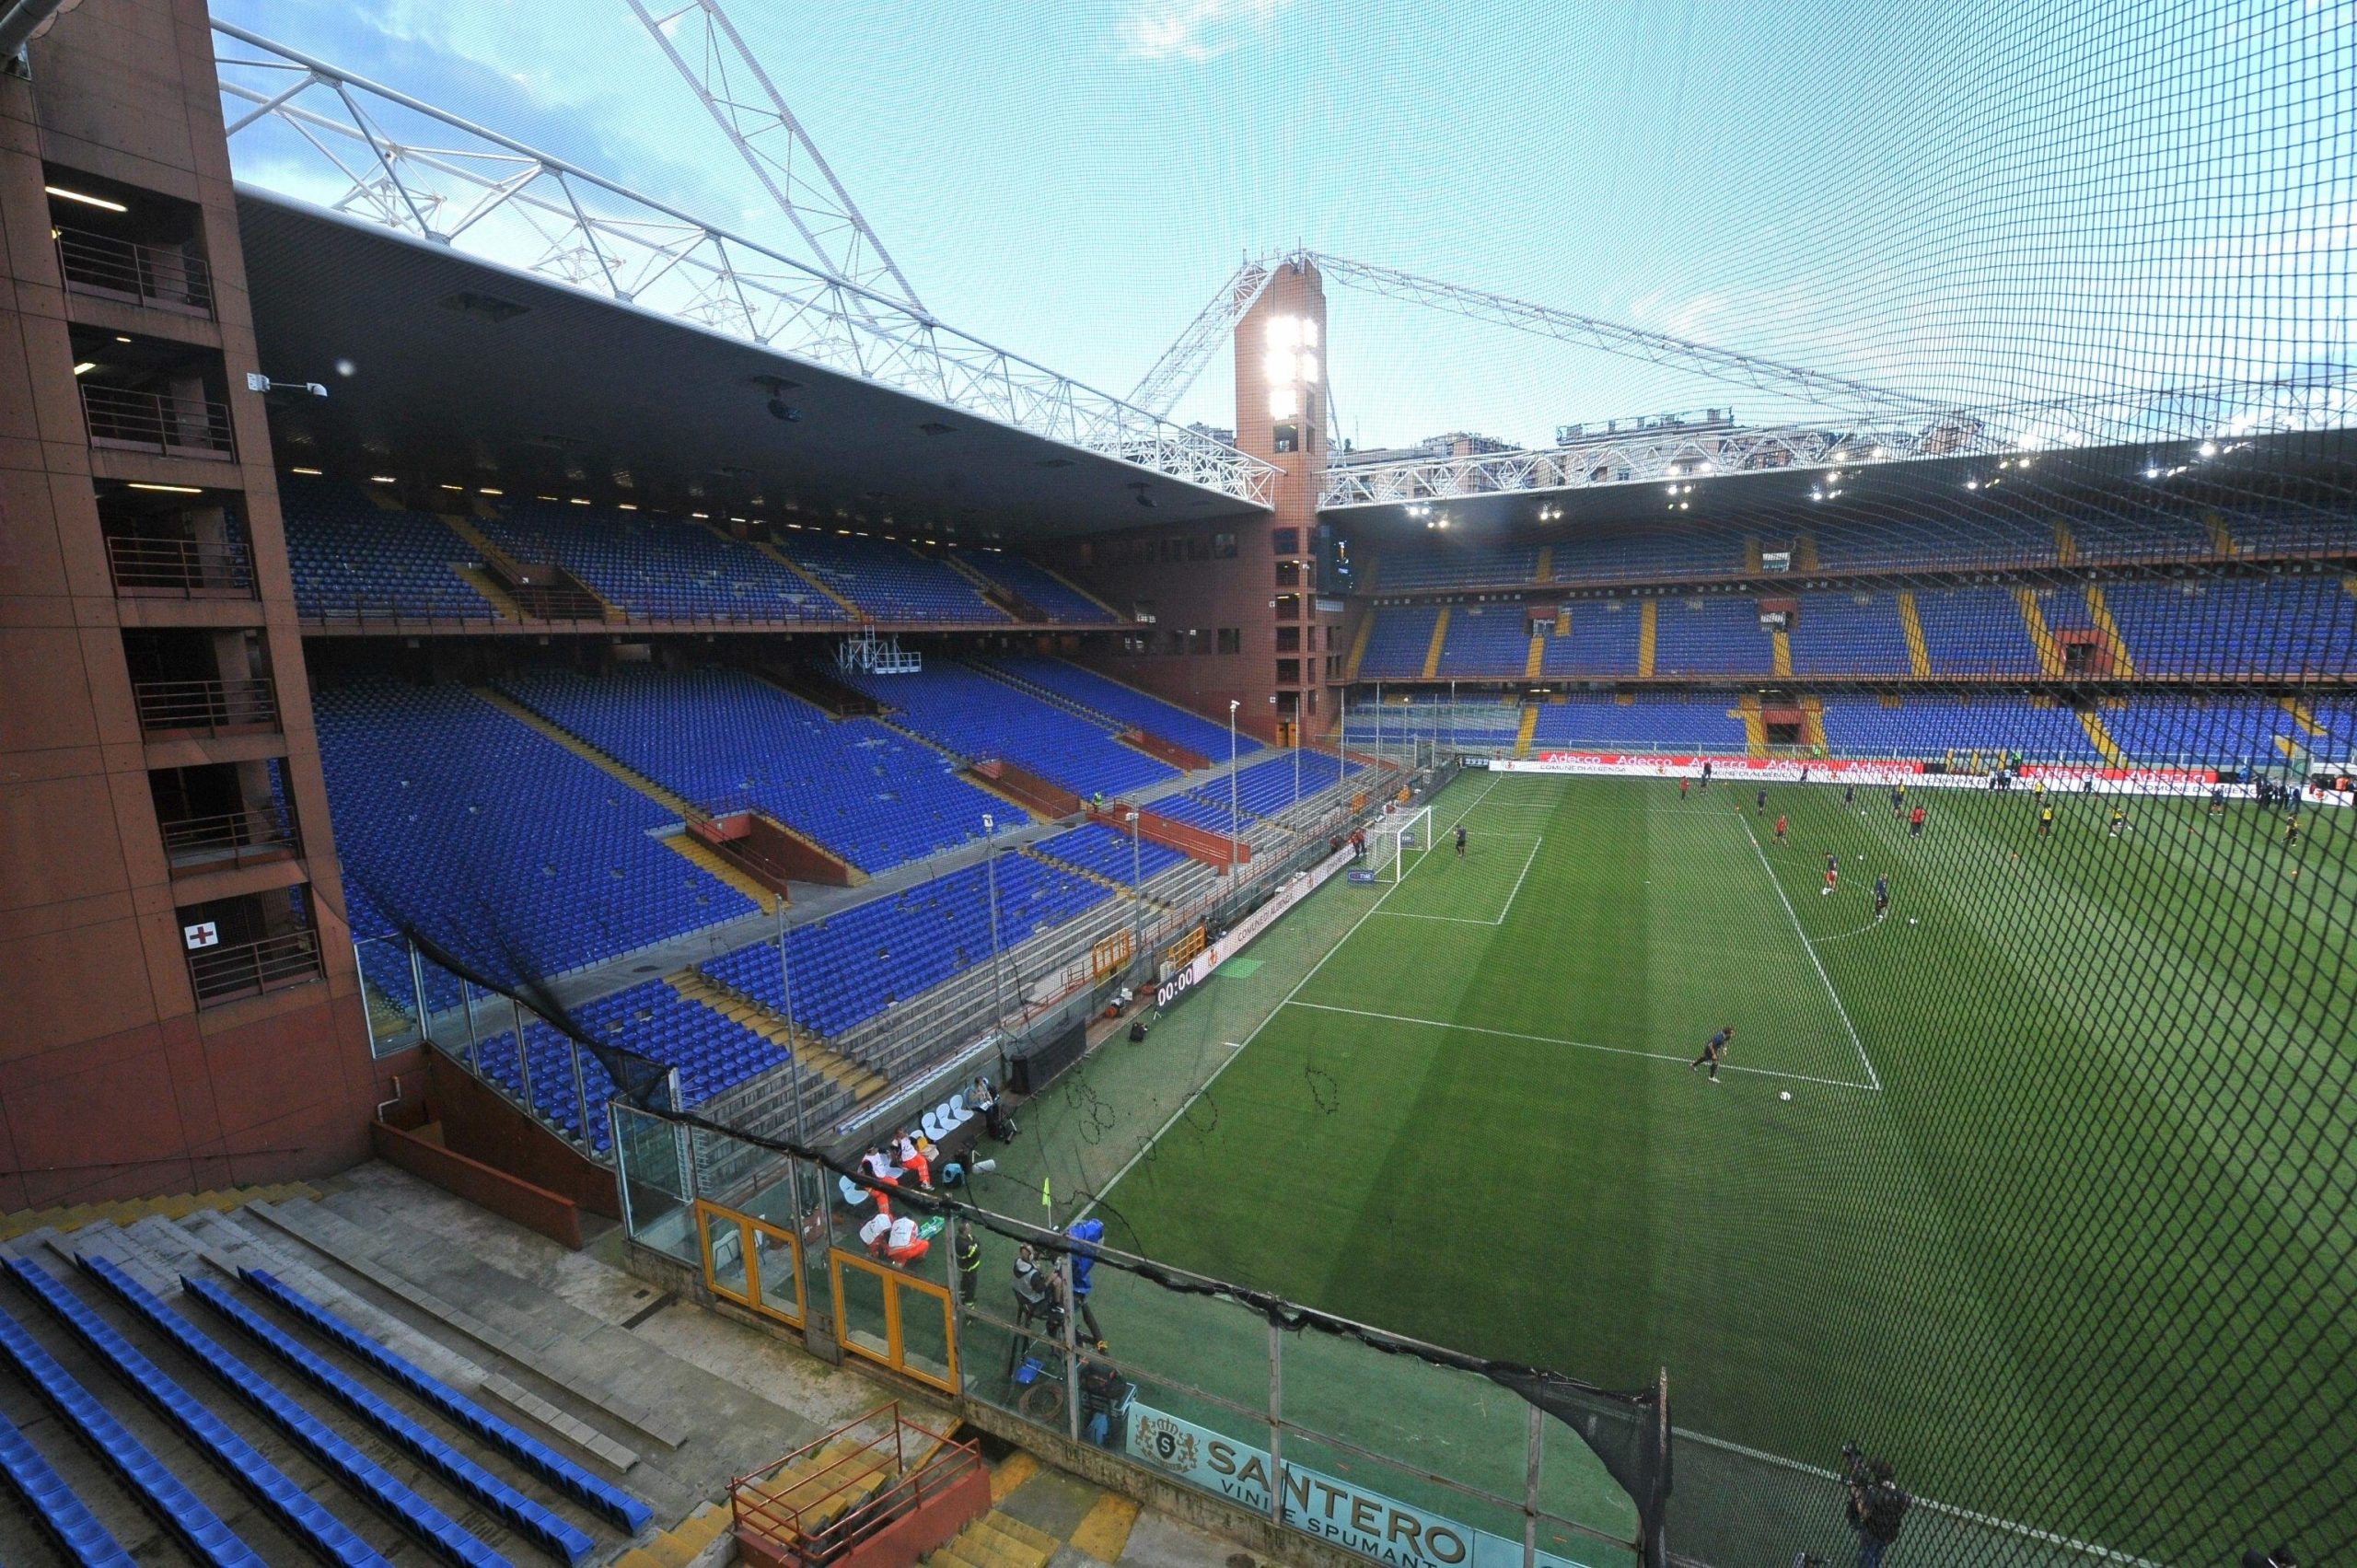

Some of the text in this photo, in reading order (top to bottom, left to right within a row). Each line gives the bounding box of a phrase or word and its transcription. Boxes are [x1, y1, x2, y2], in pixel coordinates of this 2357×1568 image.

[1548, 753, 1601, 764] Adecco
[1617, 755, 1673, 766] Adecco
[1767, 759, 1829, 772] Adecco
[1157, 968, 1193, 1006] 00:00
[1161, 1437, 1171, 1453] S
[1206, 1440, 1467, 1564] SANTERO
[1221, 1479, 1271, 1510] VINI
